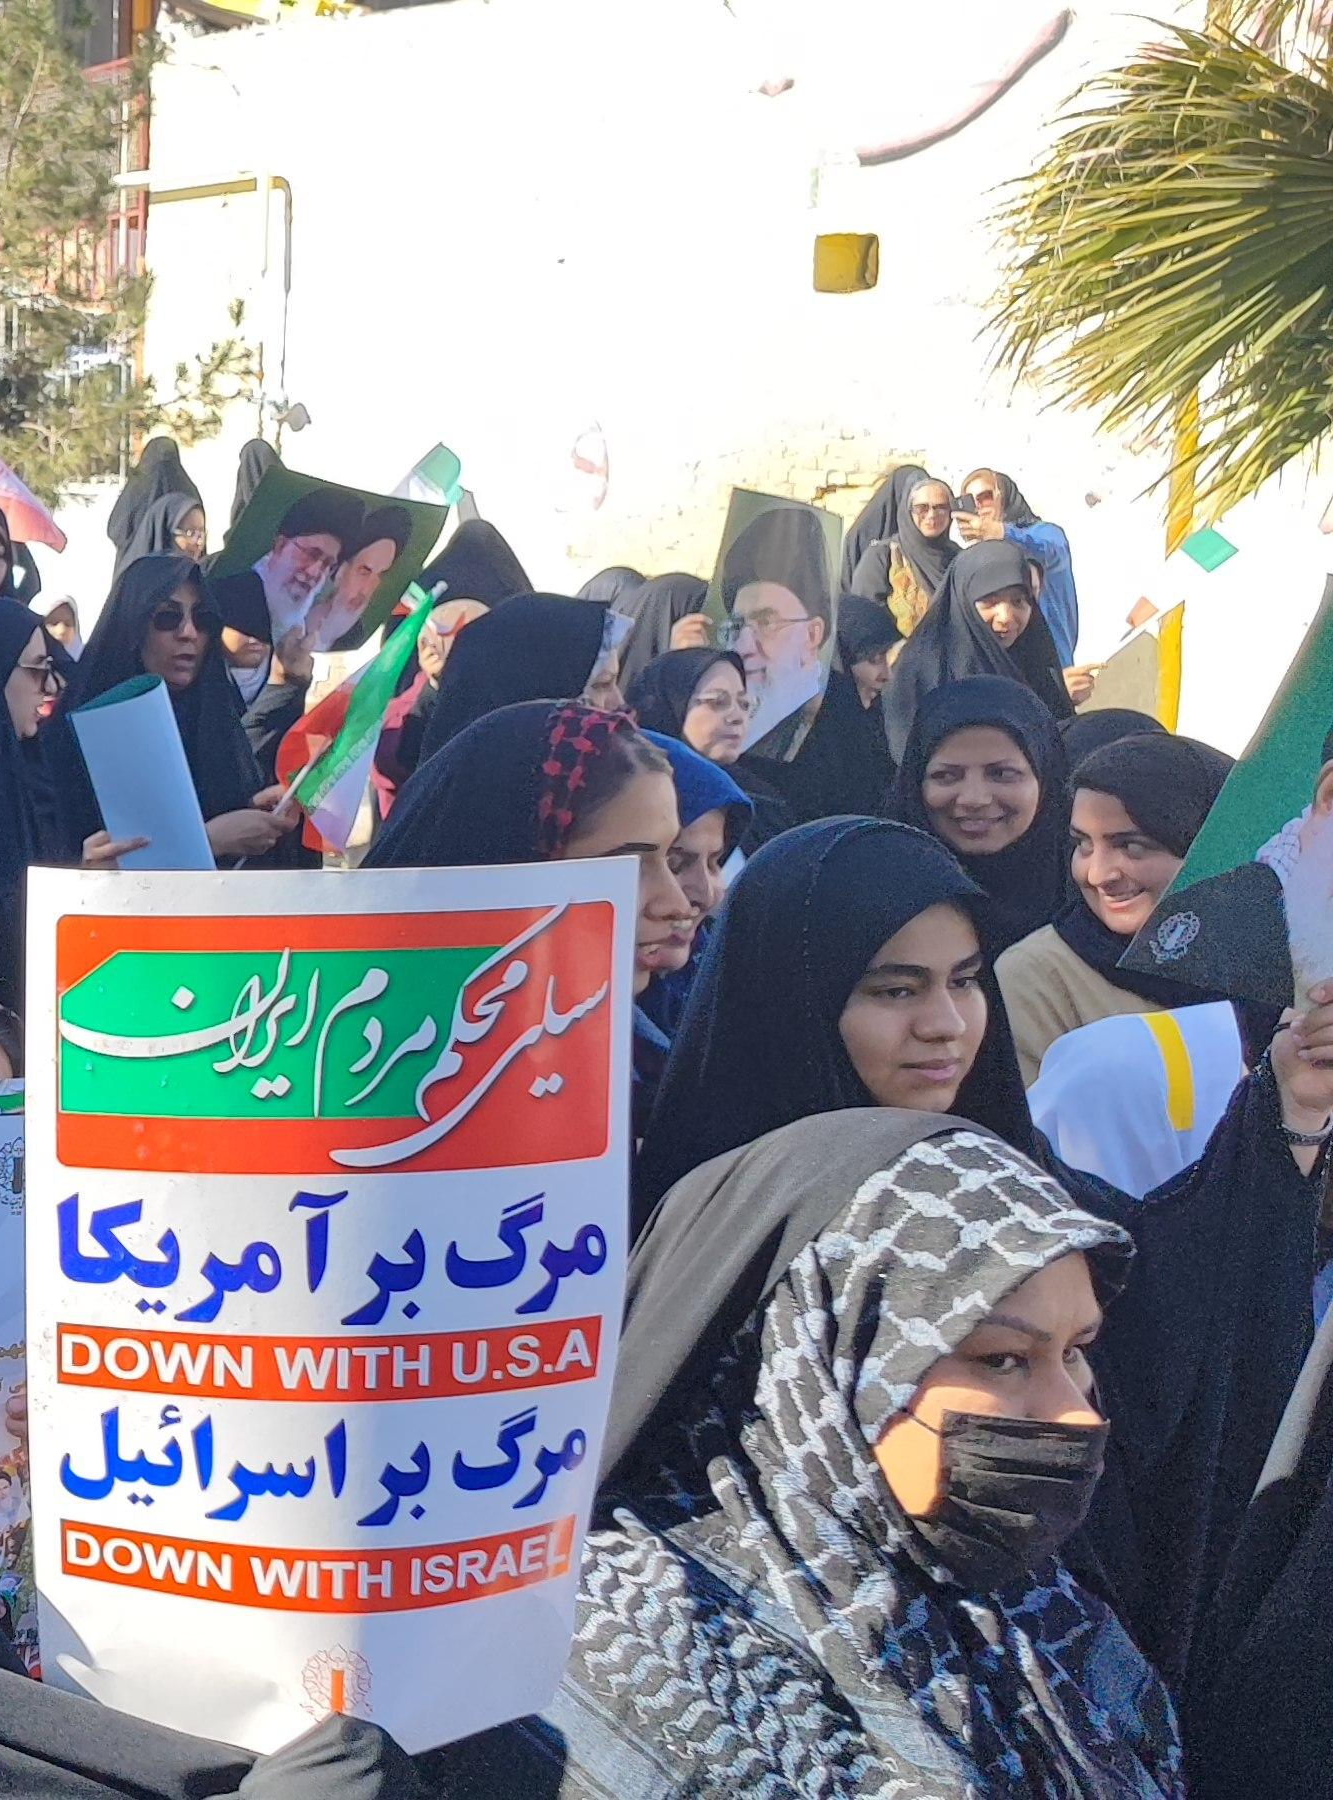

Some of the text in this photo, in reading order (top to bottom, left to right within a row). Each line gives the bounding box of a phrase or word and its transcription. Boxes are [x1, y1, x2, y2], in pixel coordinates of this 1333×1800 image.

[58, 902, 609, 1168] سیلی محکم مردم ایران
[56, 1190, 609, 1327] مرگ بر آمریکا
[60, 1328, 593, 1390] DOWN WITH U.S.A
[59, 1405, 588, 1528] مرگ بر اسرائیل
[65, 1529, 567, 1600] DOWN WITH ISRAEL
